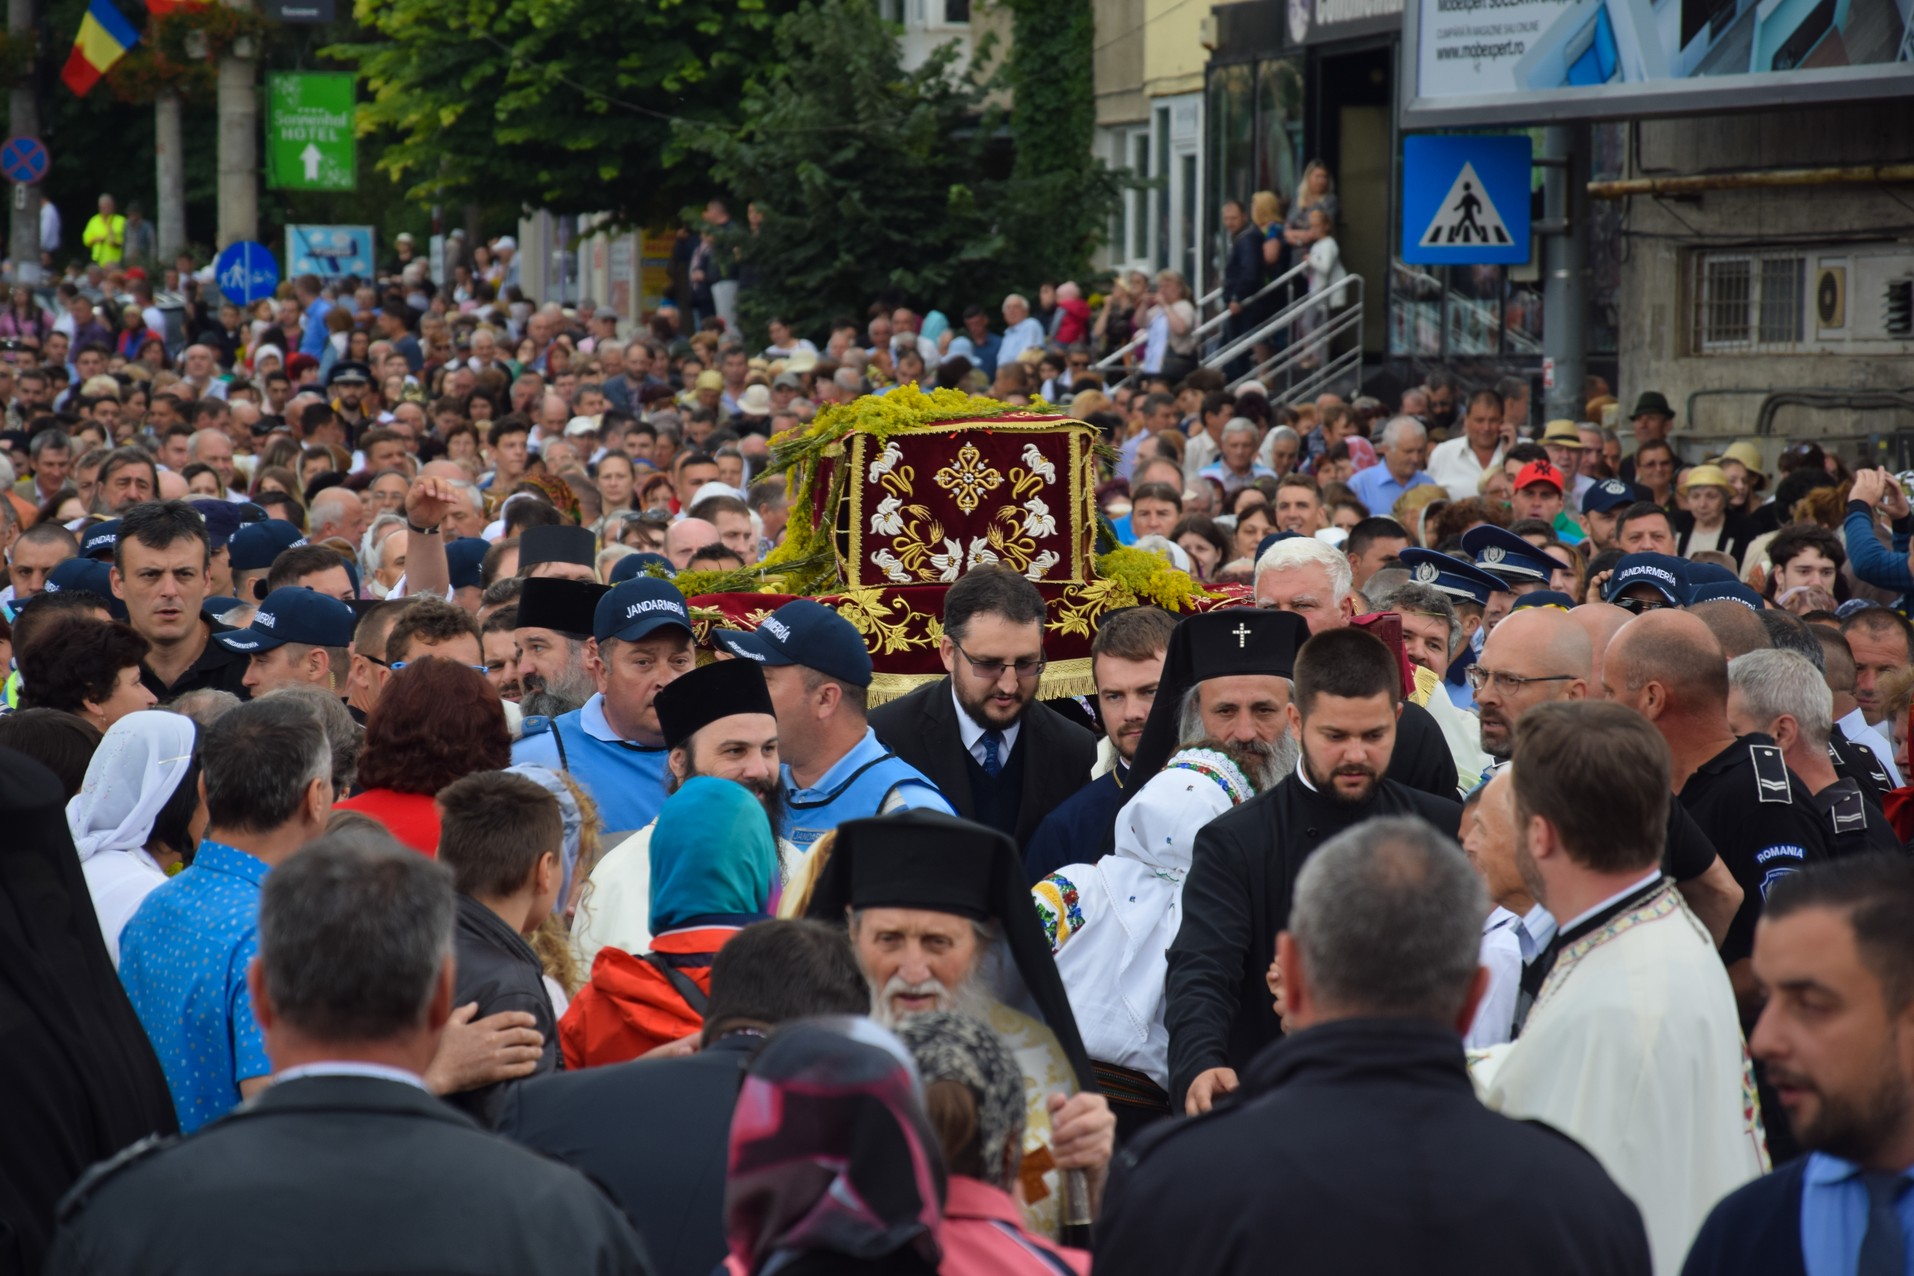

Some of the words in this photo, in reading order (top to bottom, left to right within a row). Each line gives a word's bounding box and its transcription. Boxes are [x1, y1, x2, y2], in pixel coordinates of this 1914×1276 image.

[1436, 40, 1525, 61] www.mobexpert.ro
[281, 127, 339, 142] HOTEL
[1757, 845, 1803, 863] ROMANIA
